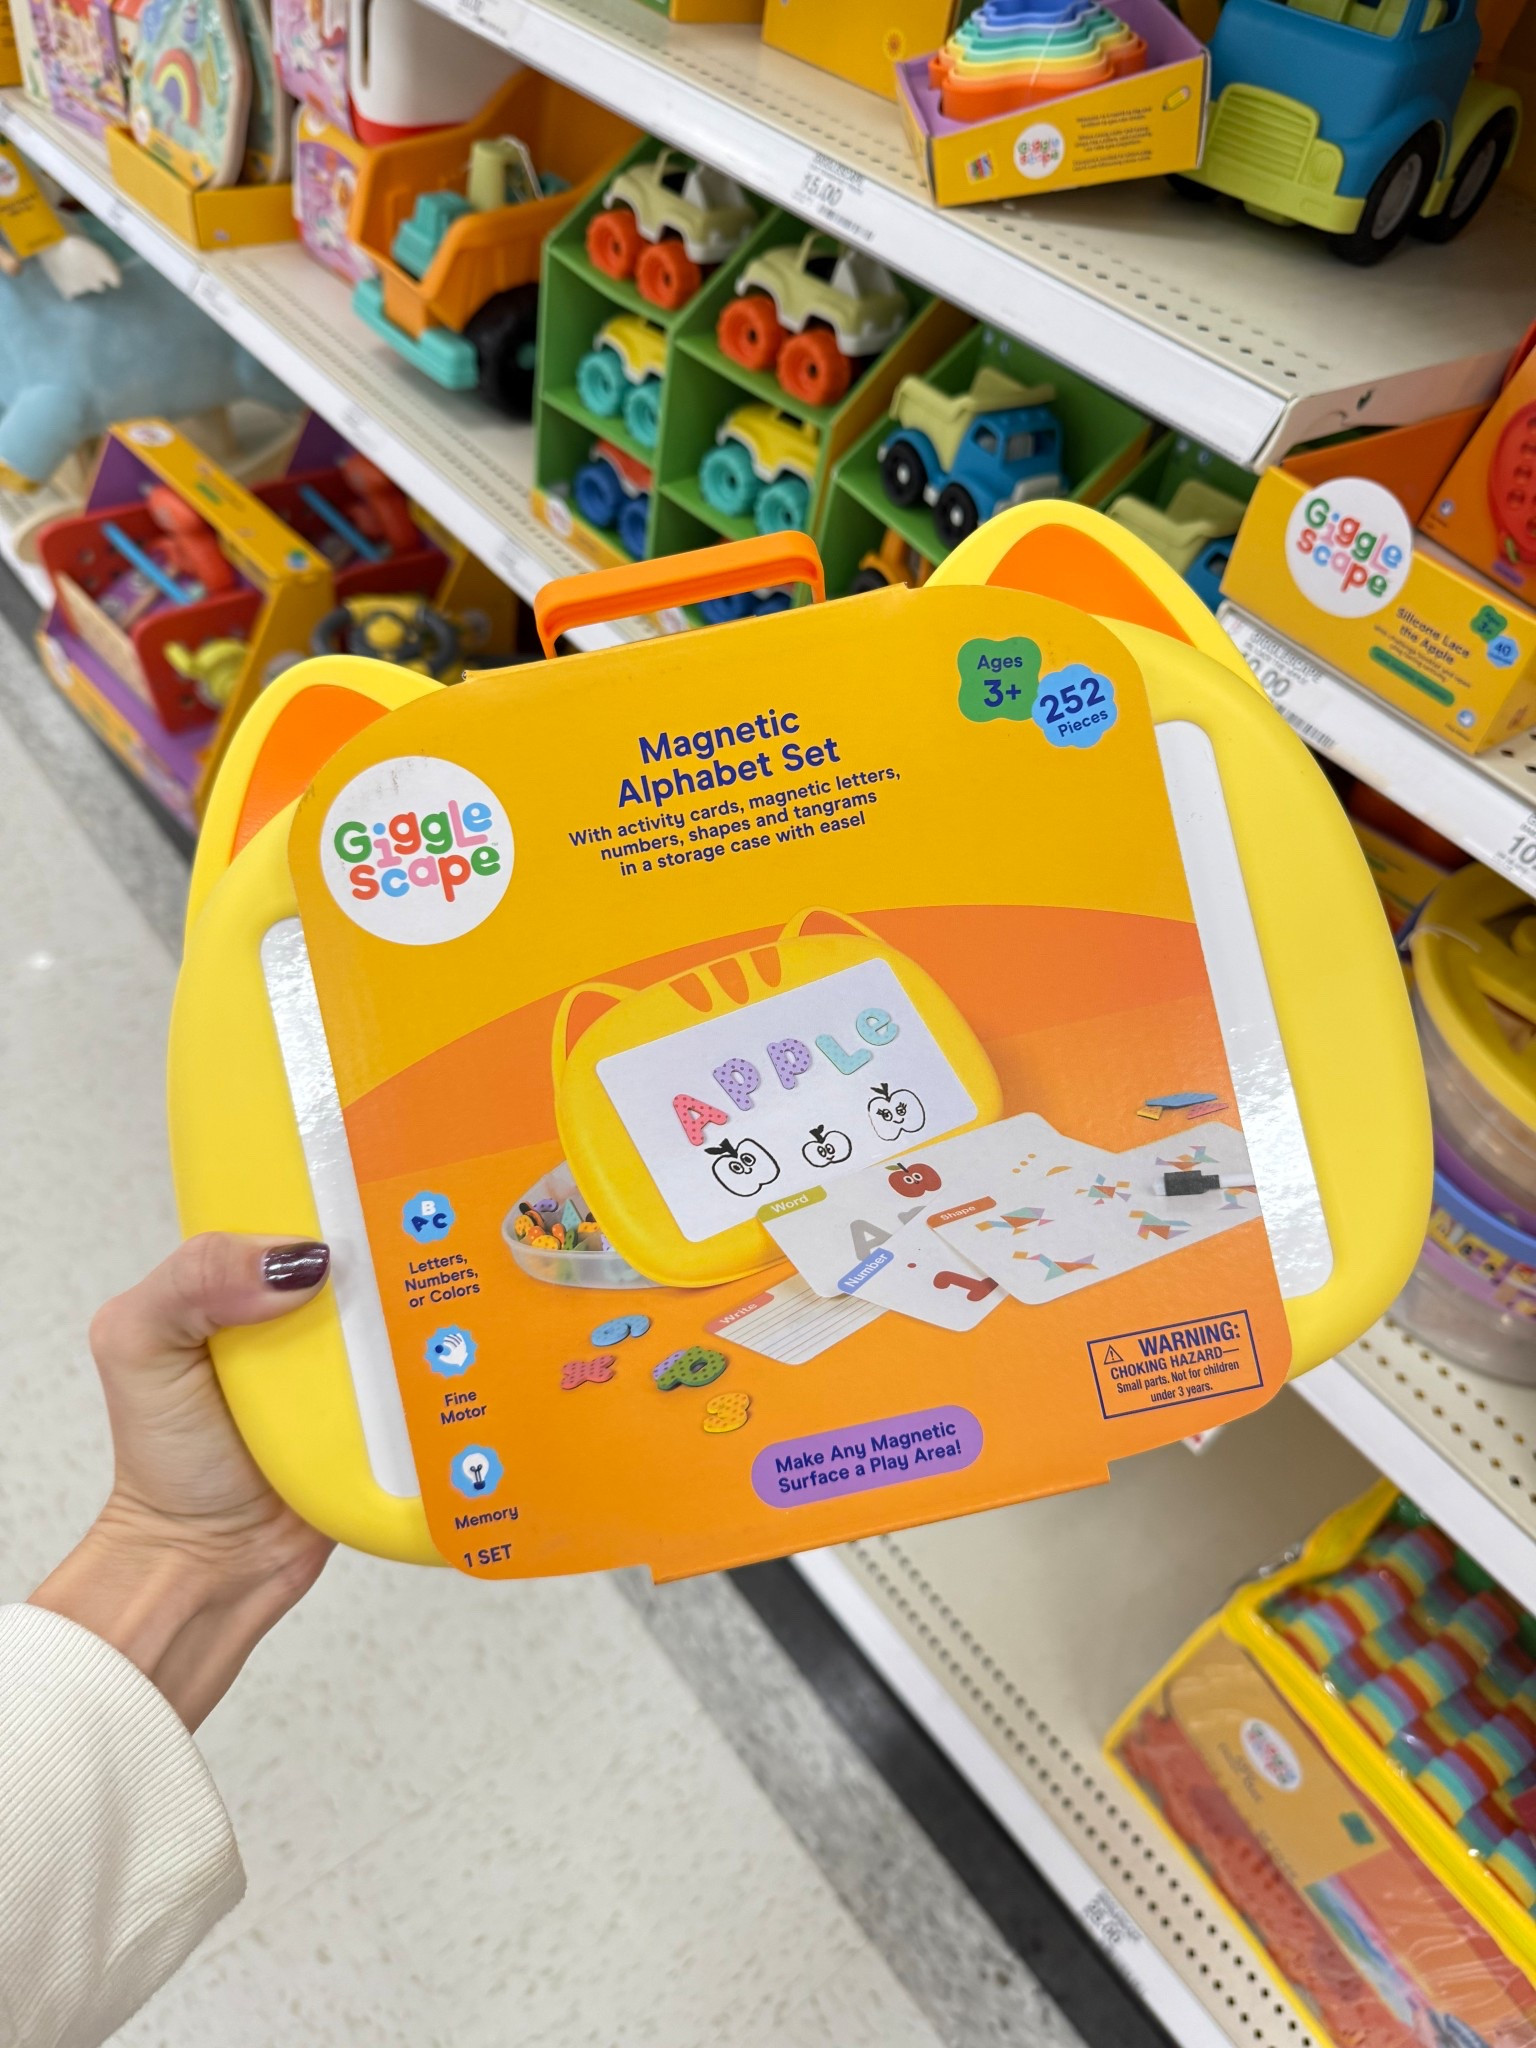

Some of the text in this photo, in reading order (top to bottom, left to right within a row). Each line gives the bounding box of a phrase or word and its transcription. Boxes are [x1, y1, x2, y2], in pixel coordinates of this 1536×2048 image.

[1296, 528, 1388, 597] scape
[977, 655, 1023, 673] Ages
[984, 680, 1021, 707] 3+
[1040, 678, 1105, 724] 252
[638, 709, 800, 764] Magnetic
[1057, 710, 1108, 737] Pieces
[618, 738, 840, 807] Alphabet Set
[569, 767, 901, 847] With activity cards, magnetic letters,
[600, 792, 877, 860] numbers, shapes and tangrams
[620, 811, 865, 876] in a storage case with easel
[349, 846, 501, 902] scape
[771, 1194, 809, 1213] Word
[940, 1205, 976, 1221] Shape
[409, 1254, 468, 1275] Letters,
[844, 1253, 888, 1288] Number
[405, 1268, 479, 1292] Numbers,
[409, 1283, 480, 1308] or Colors
[720, 1302, 757, 1326] Write
[1138, 1321, 1240, 1357] WARNING:
[1110, 1357, 1167, 1380] CHOKING
[1116, 1360, 1239, 1394] Small parts. Not for children
[444, 1391, 477, 1406] Fine
[1151, 1382, 1213, 1402] under 3 years.
[441, 1404, 487, 1425] Motor
[775, 1422, 956, 1473] Make Any Magnetic
[778, 1439, 962, 1493] Surface a Play Area!
[455, 1506, 519, 1530] Memory
[464, 1544, 512, 1568] 1 SET
